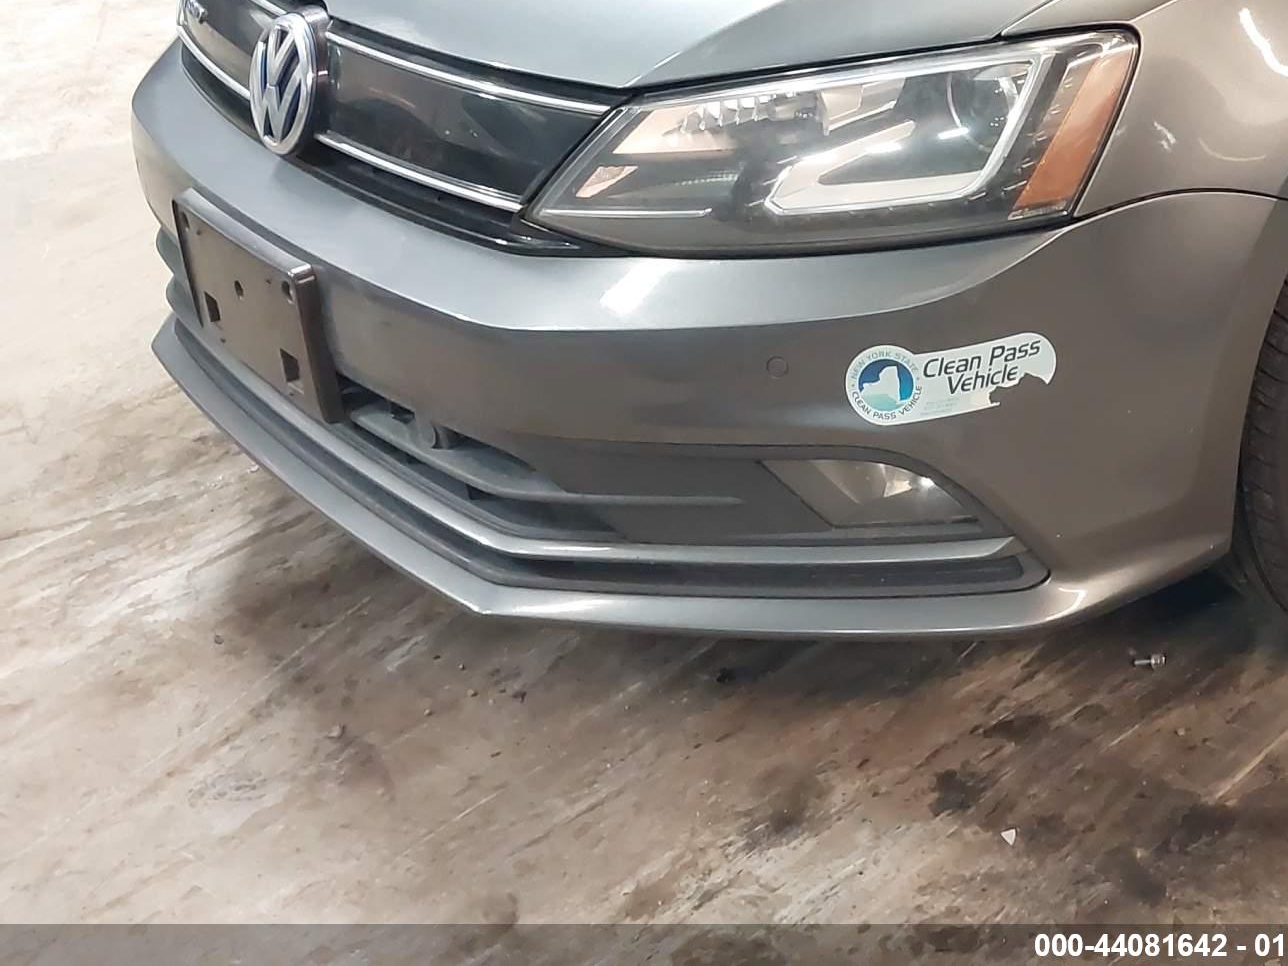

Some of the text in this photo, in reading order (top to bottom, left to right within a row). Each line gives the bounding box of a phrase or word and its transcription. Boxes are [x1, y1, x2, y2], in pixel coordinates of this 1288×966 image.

[851, 358, 867, 380] NEW
[866, 350, 892, 360] YORK
[923, 340, 1041, 378] Clean Pass
[947, 364, 1018, 395] Vehicle
[851, 391, 871, 416] CLEAN
[872, 410, 897, 420] PASS
[898, 385, 923, 416] VEHICLE
